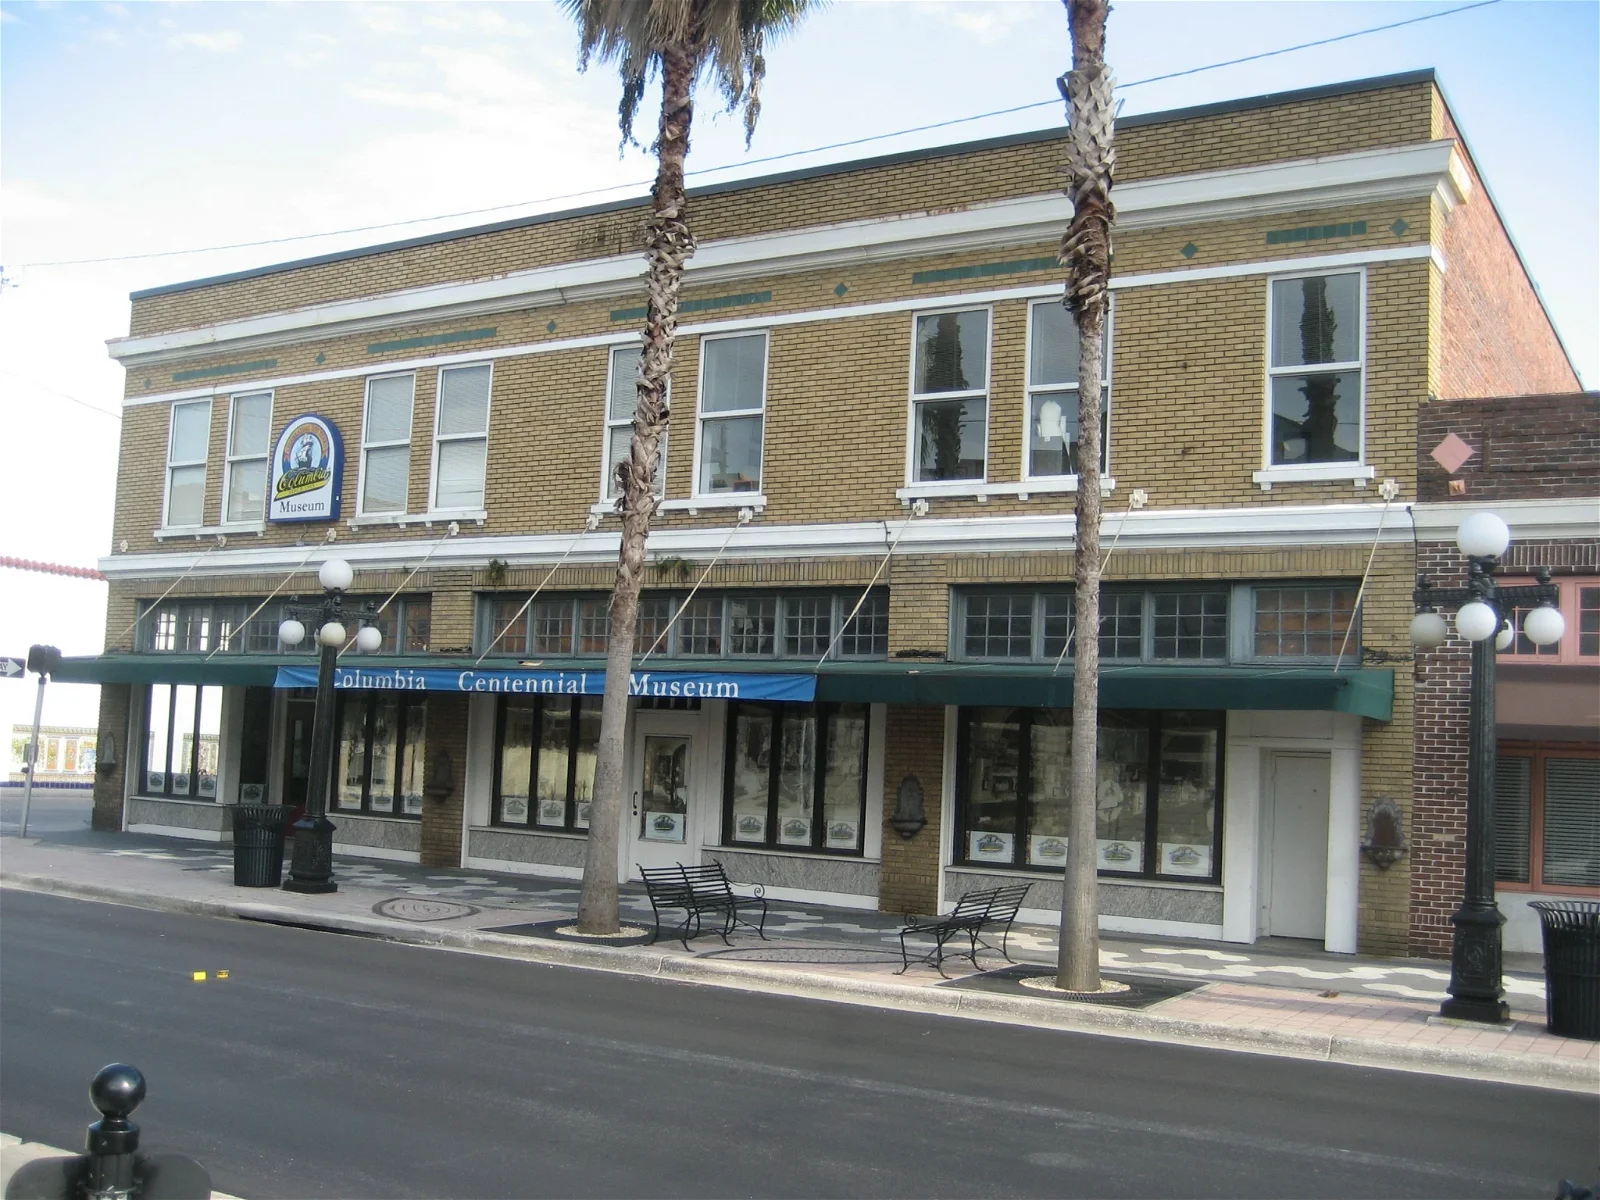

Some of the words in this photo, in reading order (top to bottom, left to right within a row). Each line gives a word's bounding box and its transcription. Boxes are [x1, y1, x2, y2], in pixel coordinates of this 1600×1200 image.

[277, 467, 330, 491] Columbia
[279, 501, 325, 513] Museum
[458, 671, 587, 694] Centennial
[628, 673, 739, 697] Museum
